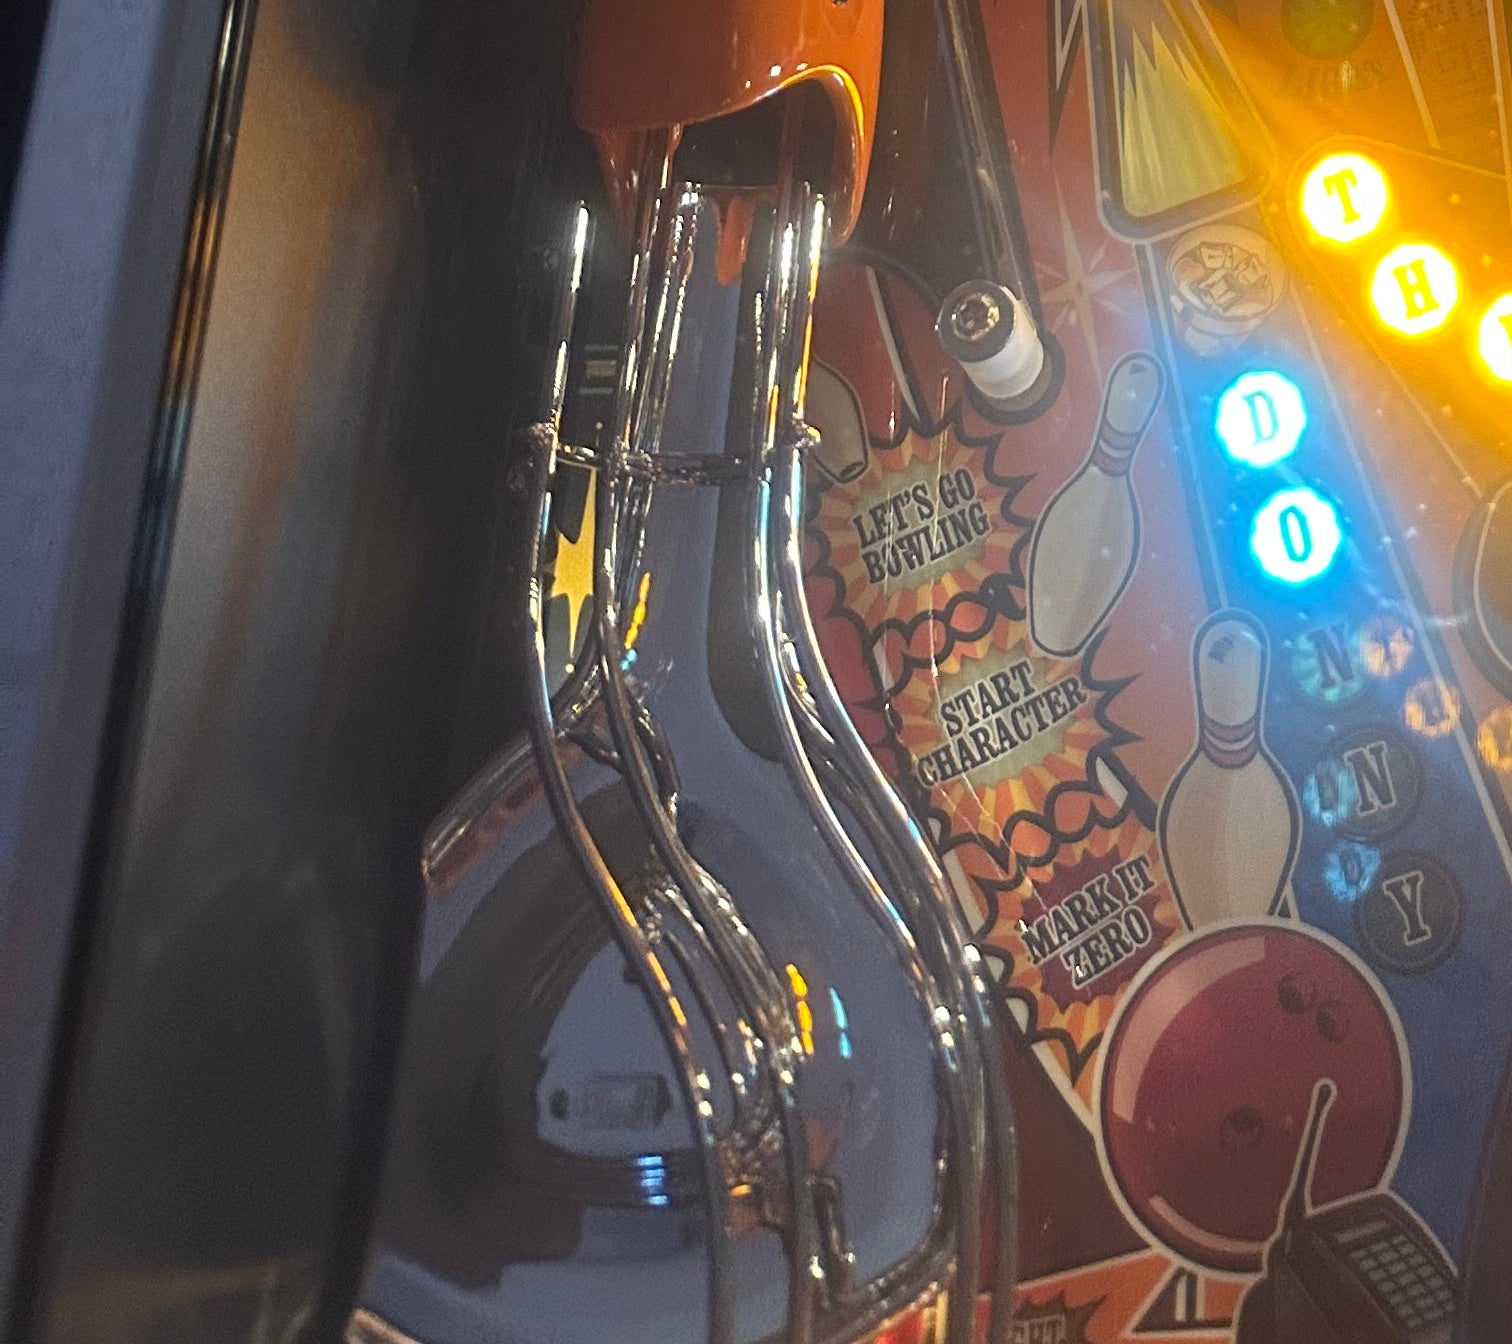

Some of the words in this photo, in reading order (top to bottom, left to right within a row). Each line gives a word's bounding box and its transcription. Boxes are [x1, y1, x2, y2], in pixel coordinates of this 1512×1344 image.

[852, 481, 935, 549] LET'S
[937, 467, 978, 509] GO
[860, 501, 994, 585] BOWLING
[915, 675, 1088, 788] CHARACTER
[939, 660, 1039, 738] START
[1021, 873, 1123, 968] MARK
[1112, 855, 1156, 905] IT
[1059, 904, 1152, 991] ZERO
